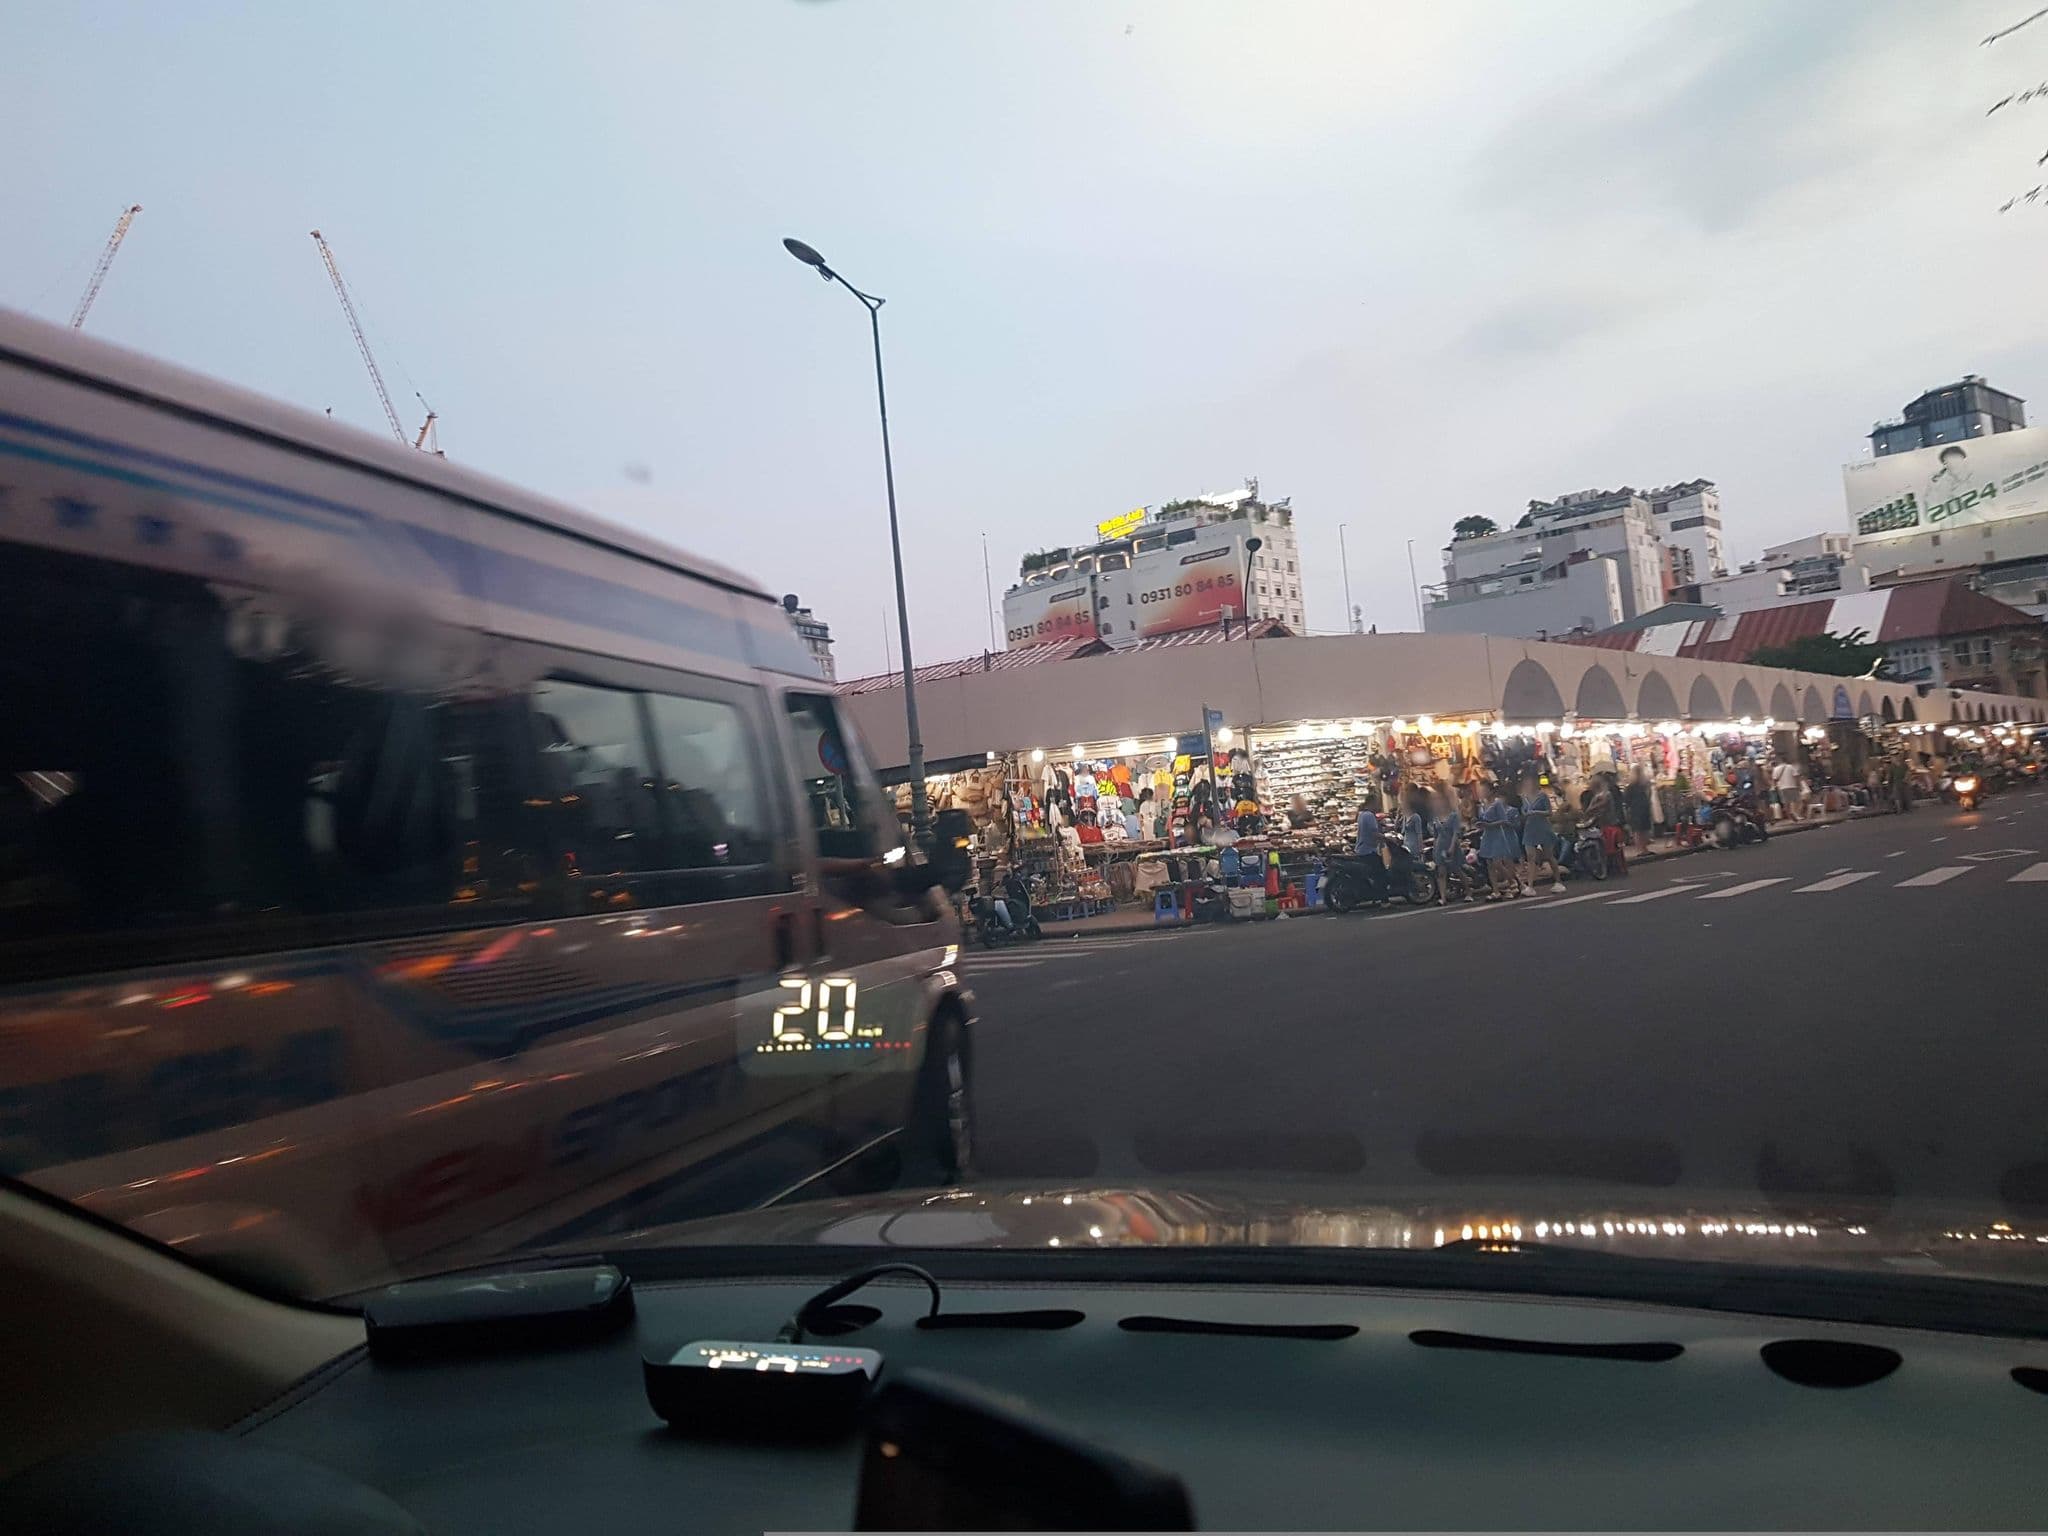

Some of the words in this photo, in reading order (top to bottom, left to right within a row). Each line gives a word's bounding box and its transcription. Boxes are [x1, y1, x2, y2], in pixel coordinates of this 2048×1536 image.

[1927, 482, 1997, 523] 2024
[1141, 587, 1171, 604] 0931
[1175, 583, 1192, 597] 80
[1218, 573, 1234, 588] 85
[1008, 624, 1034, 642] 0931
[1037, 619, 1052, 634] 80
[773, 977, 857, 1041] 20
